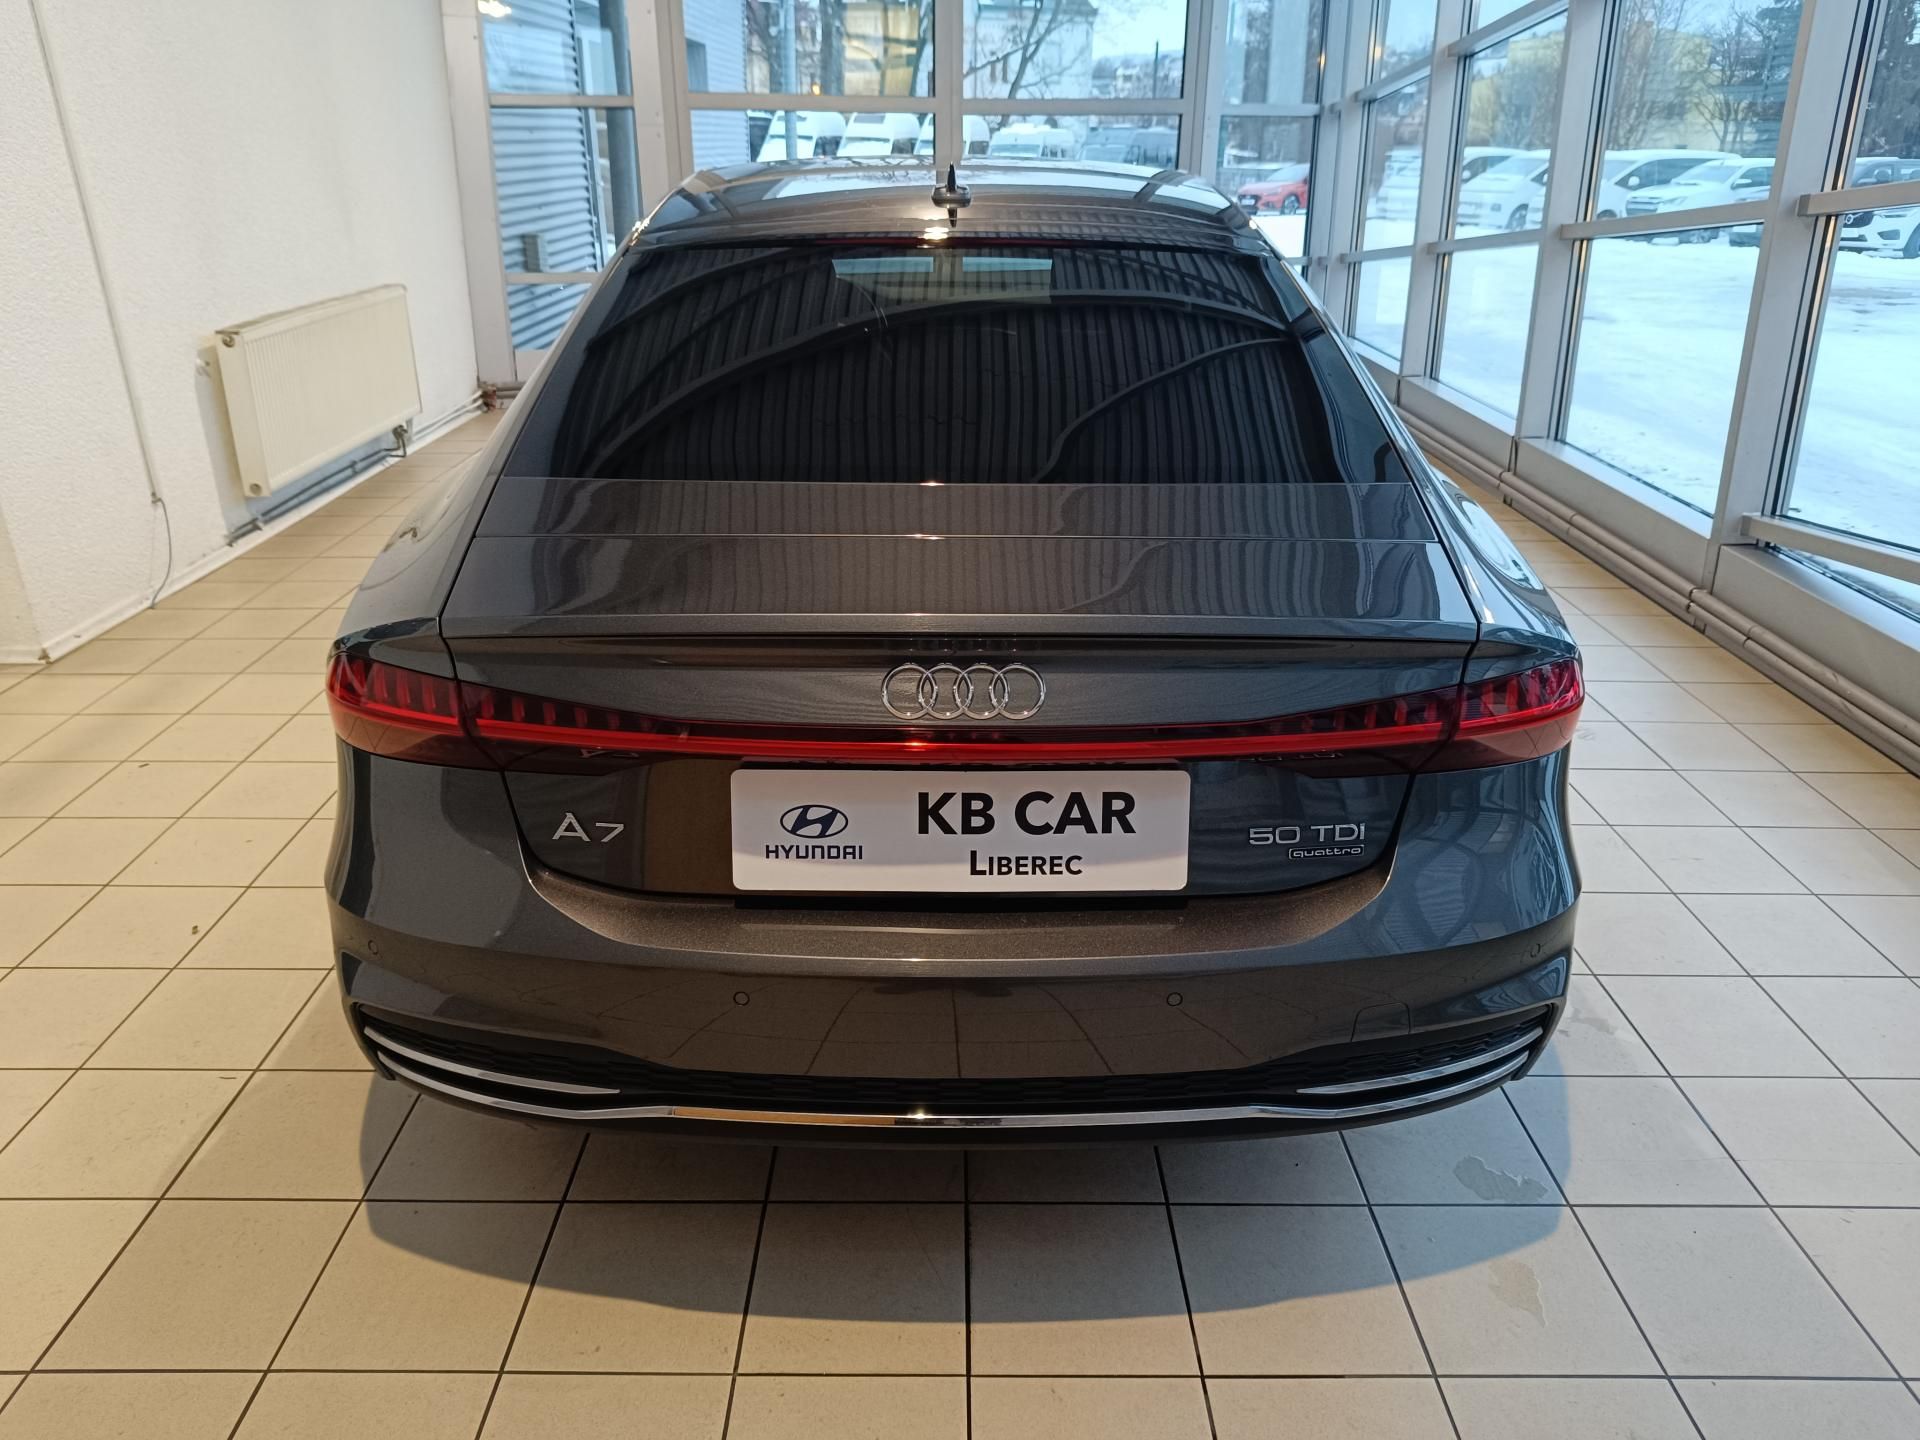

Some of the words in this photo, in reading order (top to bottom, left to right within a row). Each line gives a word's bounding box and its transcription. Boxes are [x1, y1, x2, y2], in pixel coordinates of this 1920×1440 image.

[917, 791, 996, 835] KB
[1013, 790, 1137, 836] CAR
[552, 812, 625, 843] A7
[1249, 826, 1301, 845] 50
[1310, 823, 1366, 842] TDI
[765, 844, 863, 860] HYUNDAI
[1293, 847, 1361, 859] quattro
